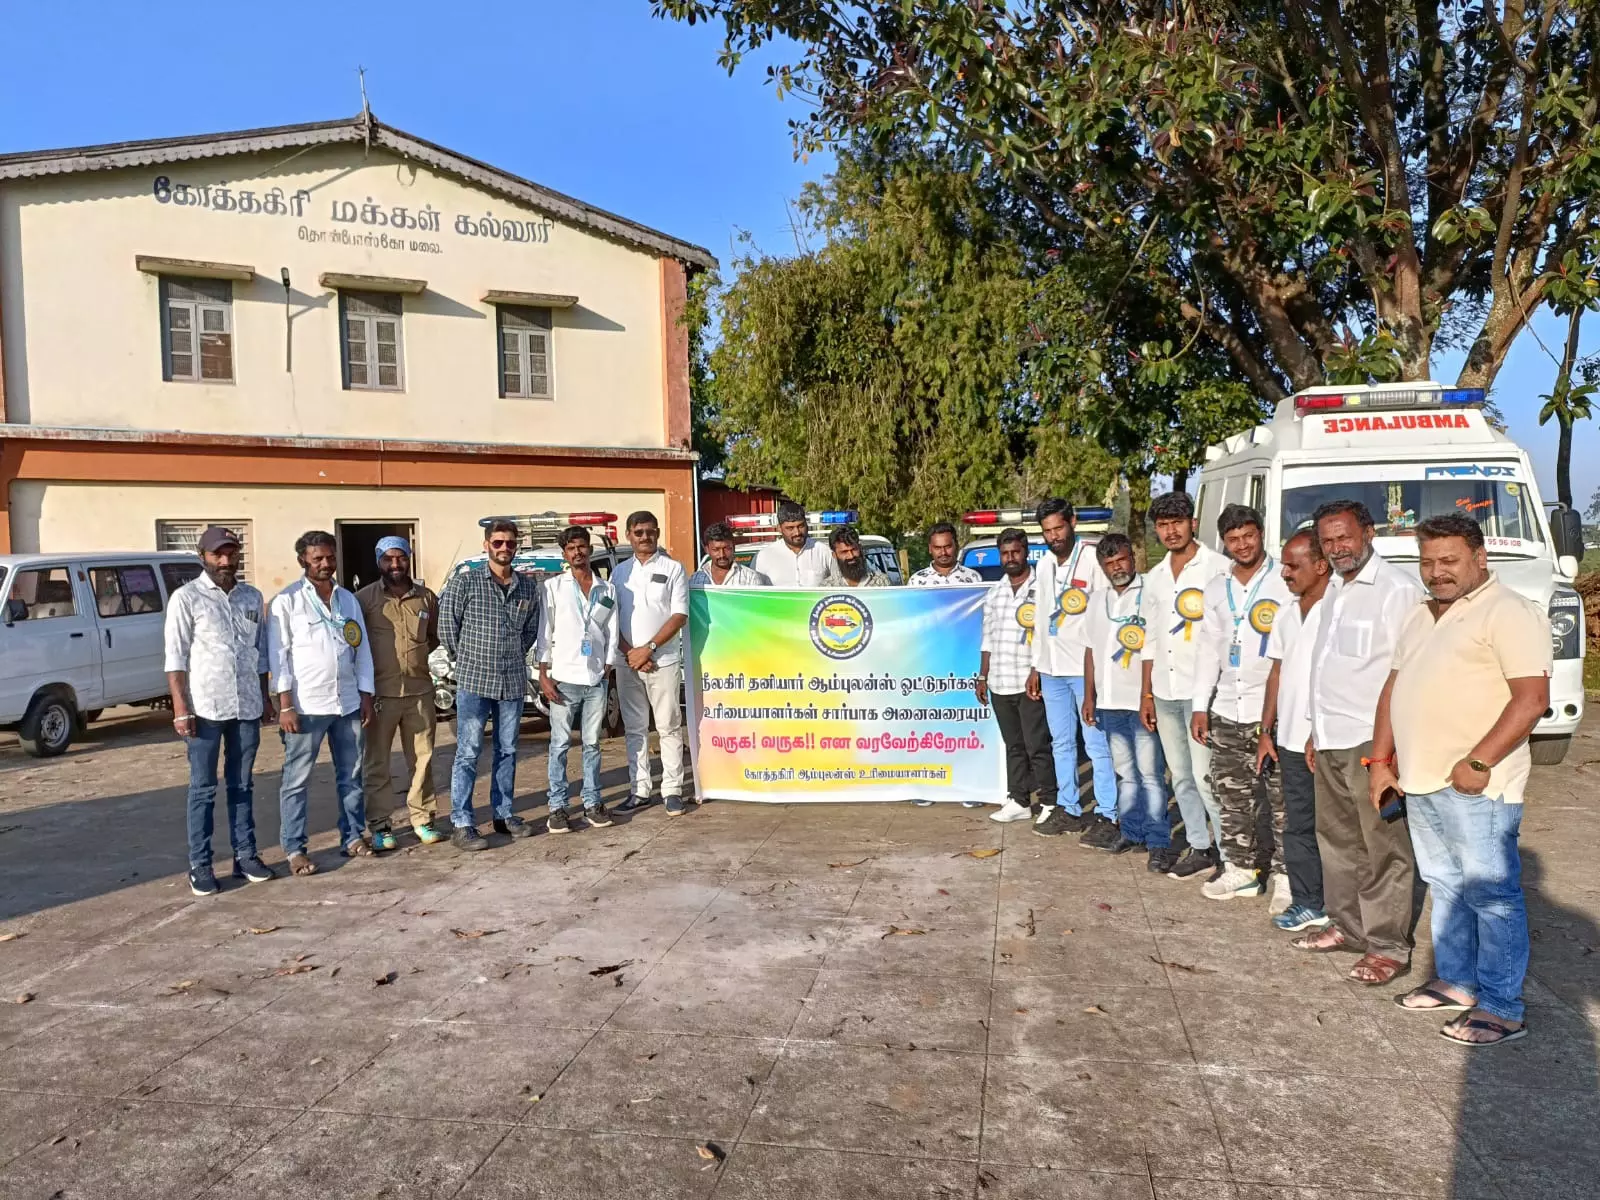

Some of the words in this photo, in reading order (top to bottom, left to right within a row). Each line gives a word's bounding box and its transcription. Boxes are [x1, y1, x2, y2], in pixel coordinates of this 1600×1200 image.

[153, 175, 311, 217] கோத்தகிரி
[331, 196, 441, 232] மக்கள்
[454, 210, 555, 243] கல்லூரி
[748, 672, 805, 693] தனியார்
[808, 672, 897, 694] ஆம்புலன்ஸ்
[703, 702, 819, 720] உரிமையாளர்கள்
[822, 702, 879, 721] சார்பாக
[711, 732, 756, 754] வருக!
[762, 732, 815, 754] வருக!!
[819, 736, 852, 750] என
[856, 730, 985, 753] வரவேற்கிறோம்.
[744, 767, 795, 781] கோத்தகிரி
[798, 767, 856, 781] ஆம்புலன்ஸ்
